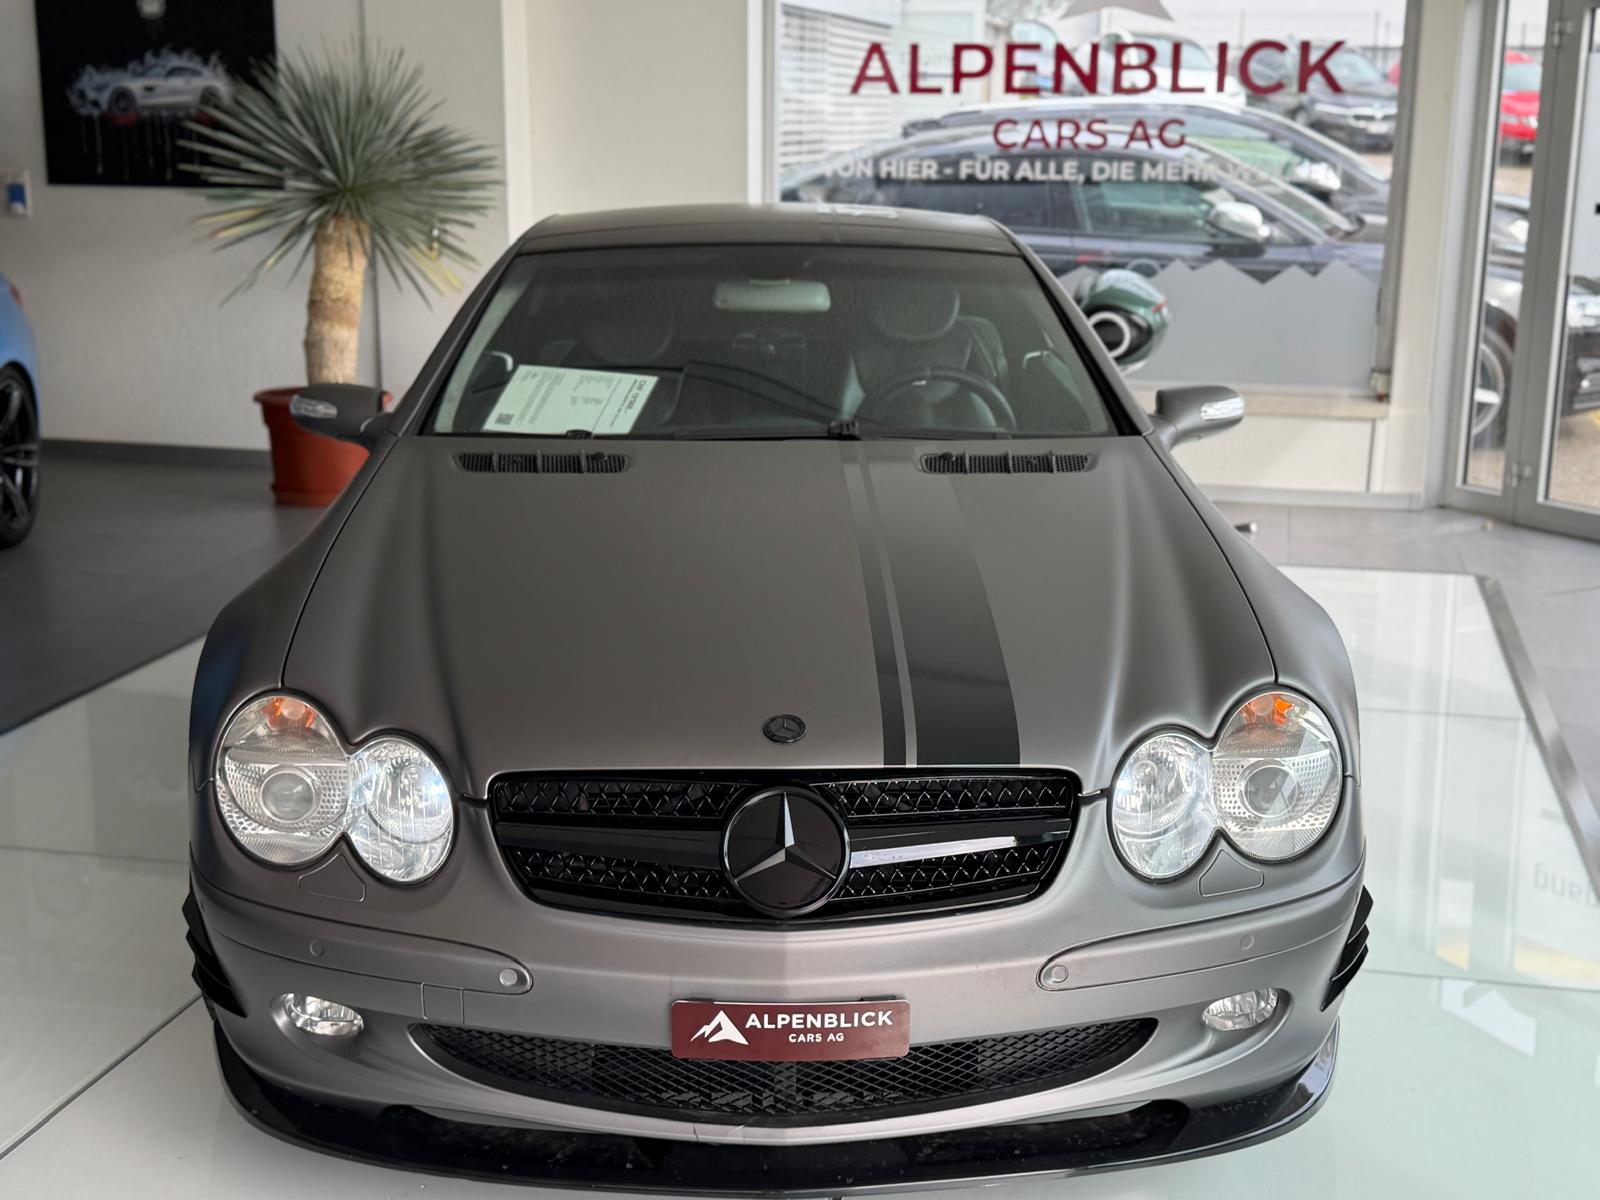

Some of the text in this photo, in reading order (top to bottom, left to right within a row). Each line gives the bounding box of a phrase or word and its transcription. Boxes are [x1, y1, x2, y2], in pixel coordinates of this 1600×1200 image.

[851, 41, 1344, 94] ALPENBLICK
[993, 118, 1186, 150] CARS AG
[880, 159, 940, 181] HIER
[959, 156, 1010, 181] FÜR
[1014, 160, 1085, 183] ALLE,
[1091, 161, 1139, 183] DIE
[745, 1011, 893, 1028] ALPENBLICK
[789, 1033, 845, 1044] CARS AG
